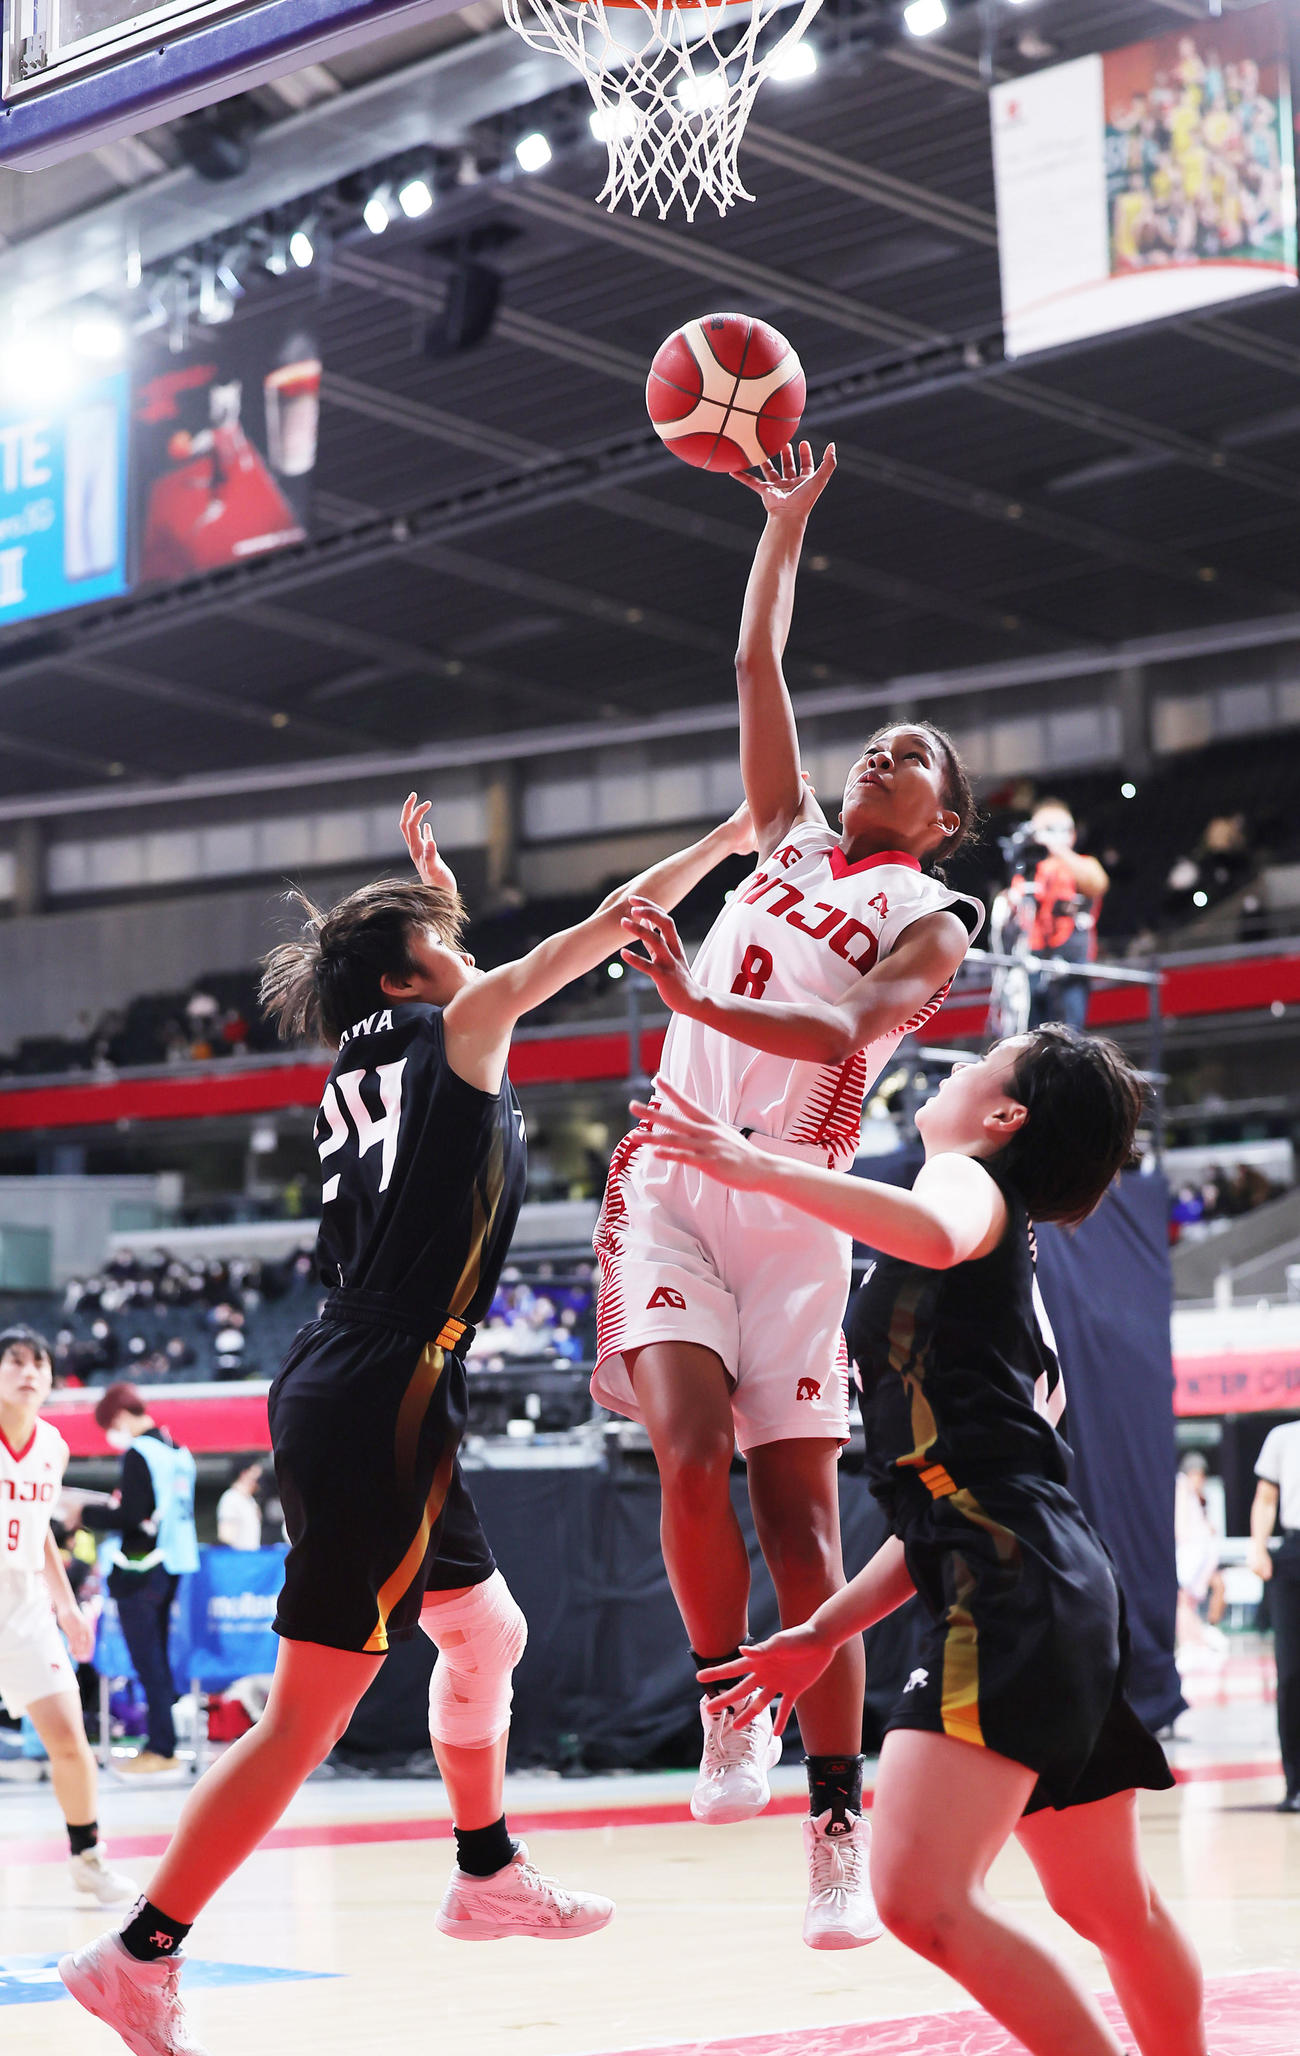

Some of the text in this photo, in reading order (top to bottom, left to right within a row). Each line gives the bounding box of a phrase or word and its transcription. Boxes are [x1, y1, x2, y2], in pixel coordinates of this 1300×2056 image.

[730, 944, 774, 1000] 8
[313, 1056, 409, 1206] 24
[646, 1286, 687, 1311] AG
[8, 1519, 20, 1551] 9
